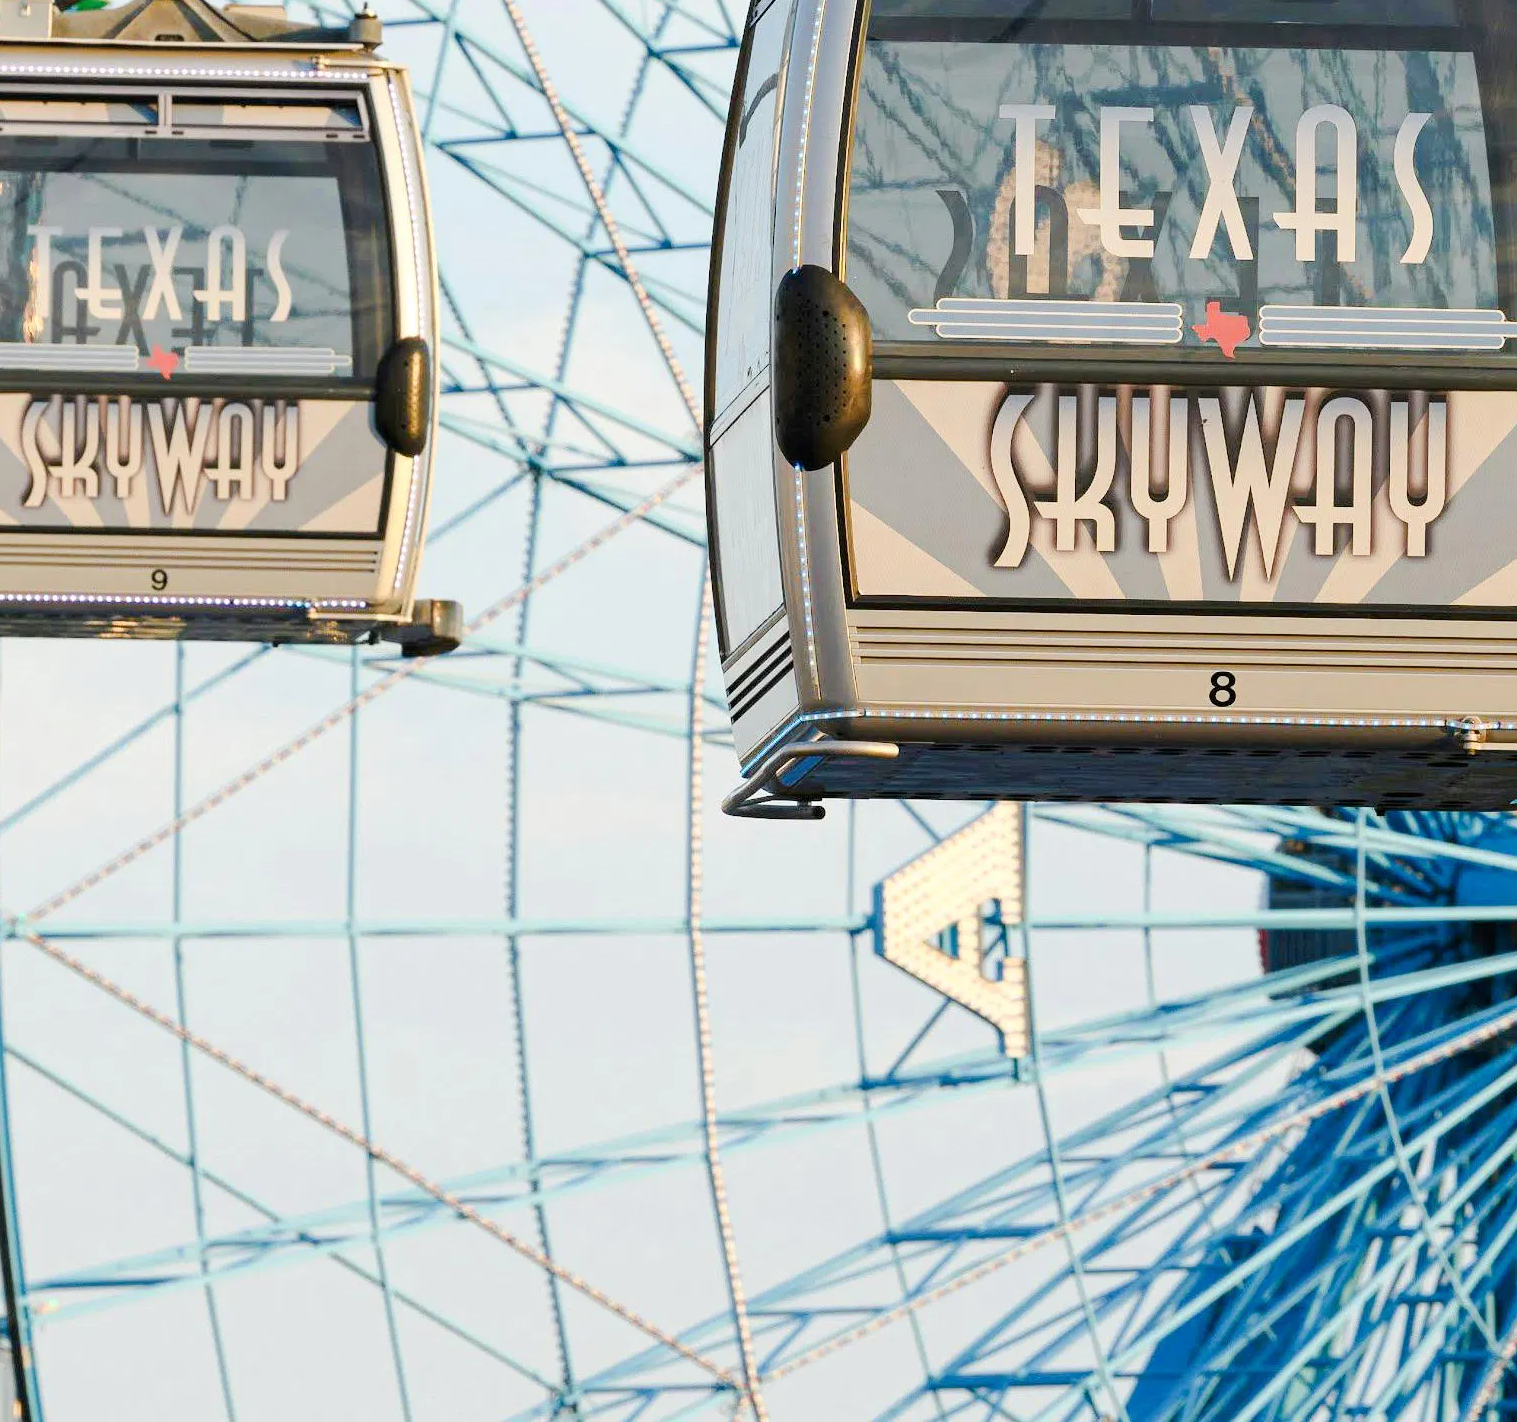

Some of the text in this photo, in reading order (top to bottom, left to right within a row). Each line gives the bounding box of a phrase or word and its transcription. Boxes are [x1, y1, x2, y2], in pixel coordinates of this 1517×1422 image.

[999, 104, 1434, 264] TEXAS
[27, 225, 292, 322] TEXAS
[21, 397, 301, 517] SKYWAY
[987, 385, 1455, 582] SKYWAY
[151, 569, 167, 590] 9
[1208, 670, 1238, 708] 8
